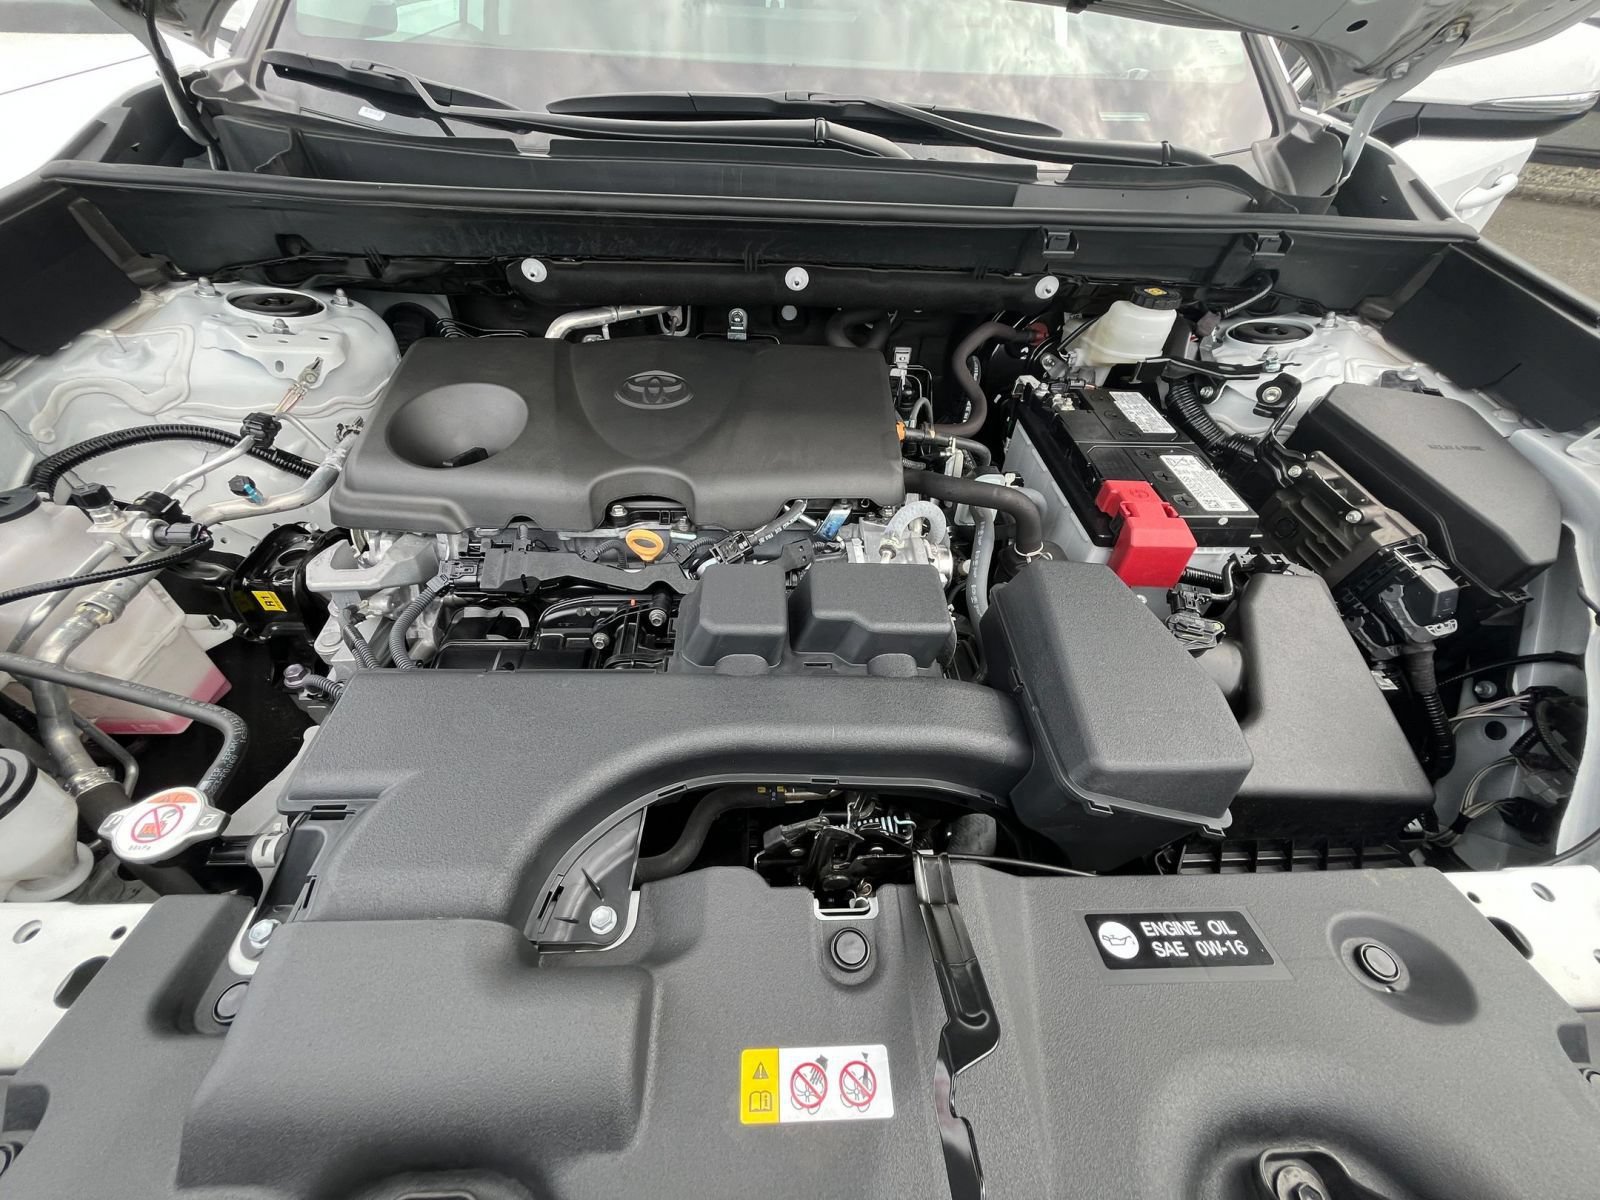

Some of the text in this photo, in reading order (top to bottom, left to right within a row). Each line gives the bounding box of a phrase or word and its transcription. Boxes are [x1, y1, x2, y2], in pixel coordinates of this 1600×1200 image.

[1140, 919, 1238, 937] ENGINE OIL
[1151, 939, 1250, 958] SAE 0W-16
